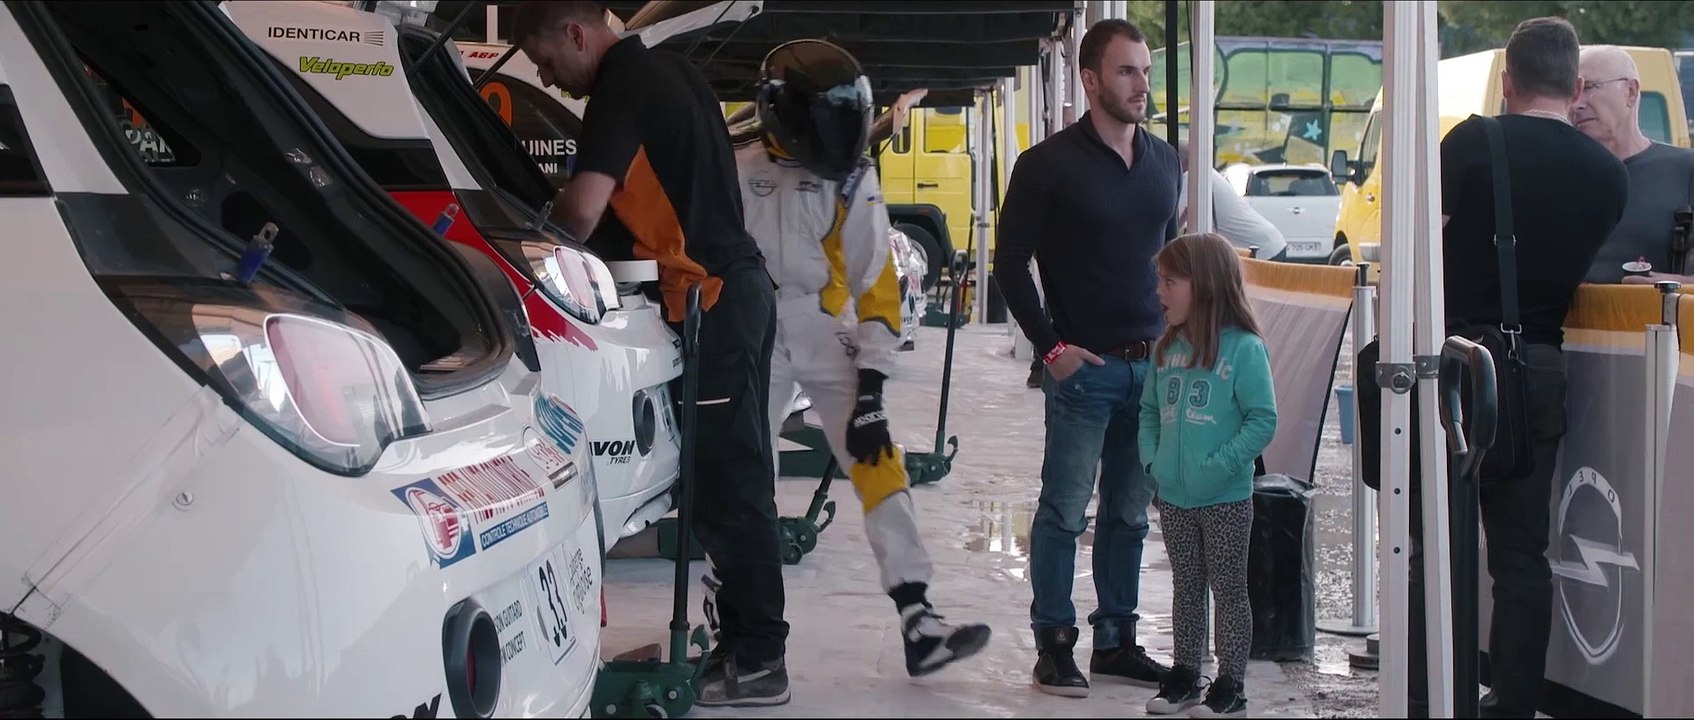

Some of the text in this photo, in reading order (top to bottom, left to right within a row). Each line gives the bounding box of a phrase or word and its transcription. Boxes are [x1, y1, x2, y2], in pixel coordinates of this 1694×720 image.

[268, 26, 360, 42] IDENTICAR
[299, 56, 395, 80] Veloperfo
[1167, 376, 1211, 409] 83
[538, 558, 568, 648] 33
